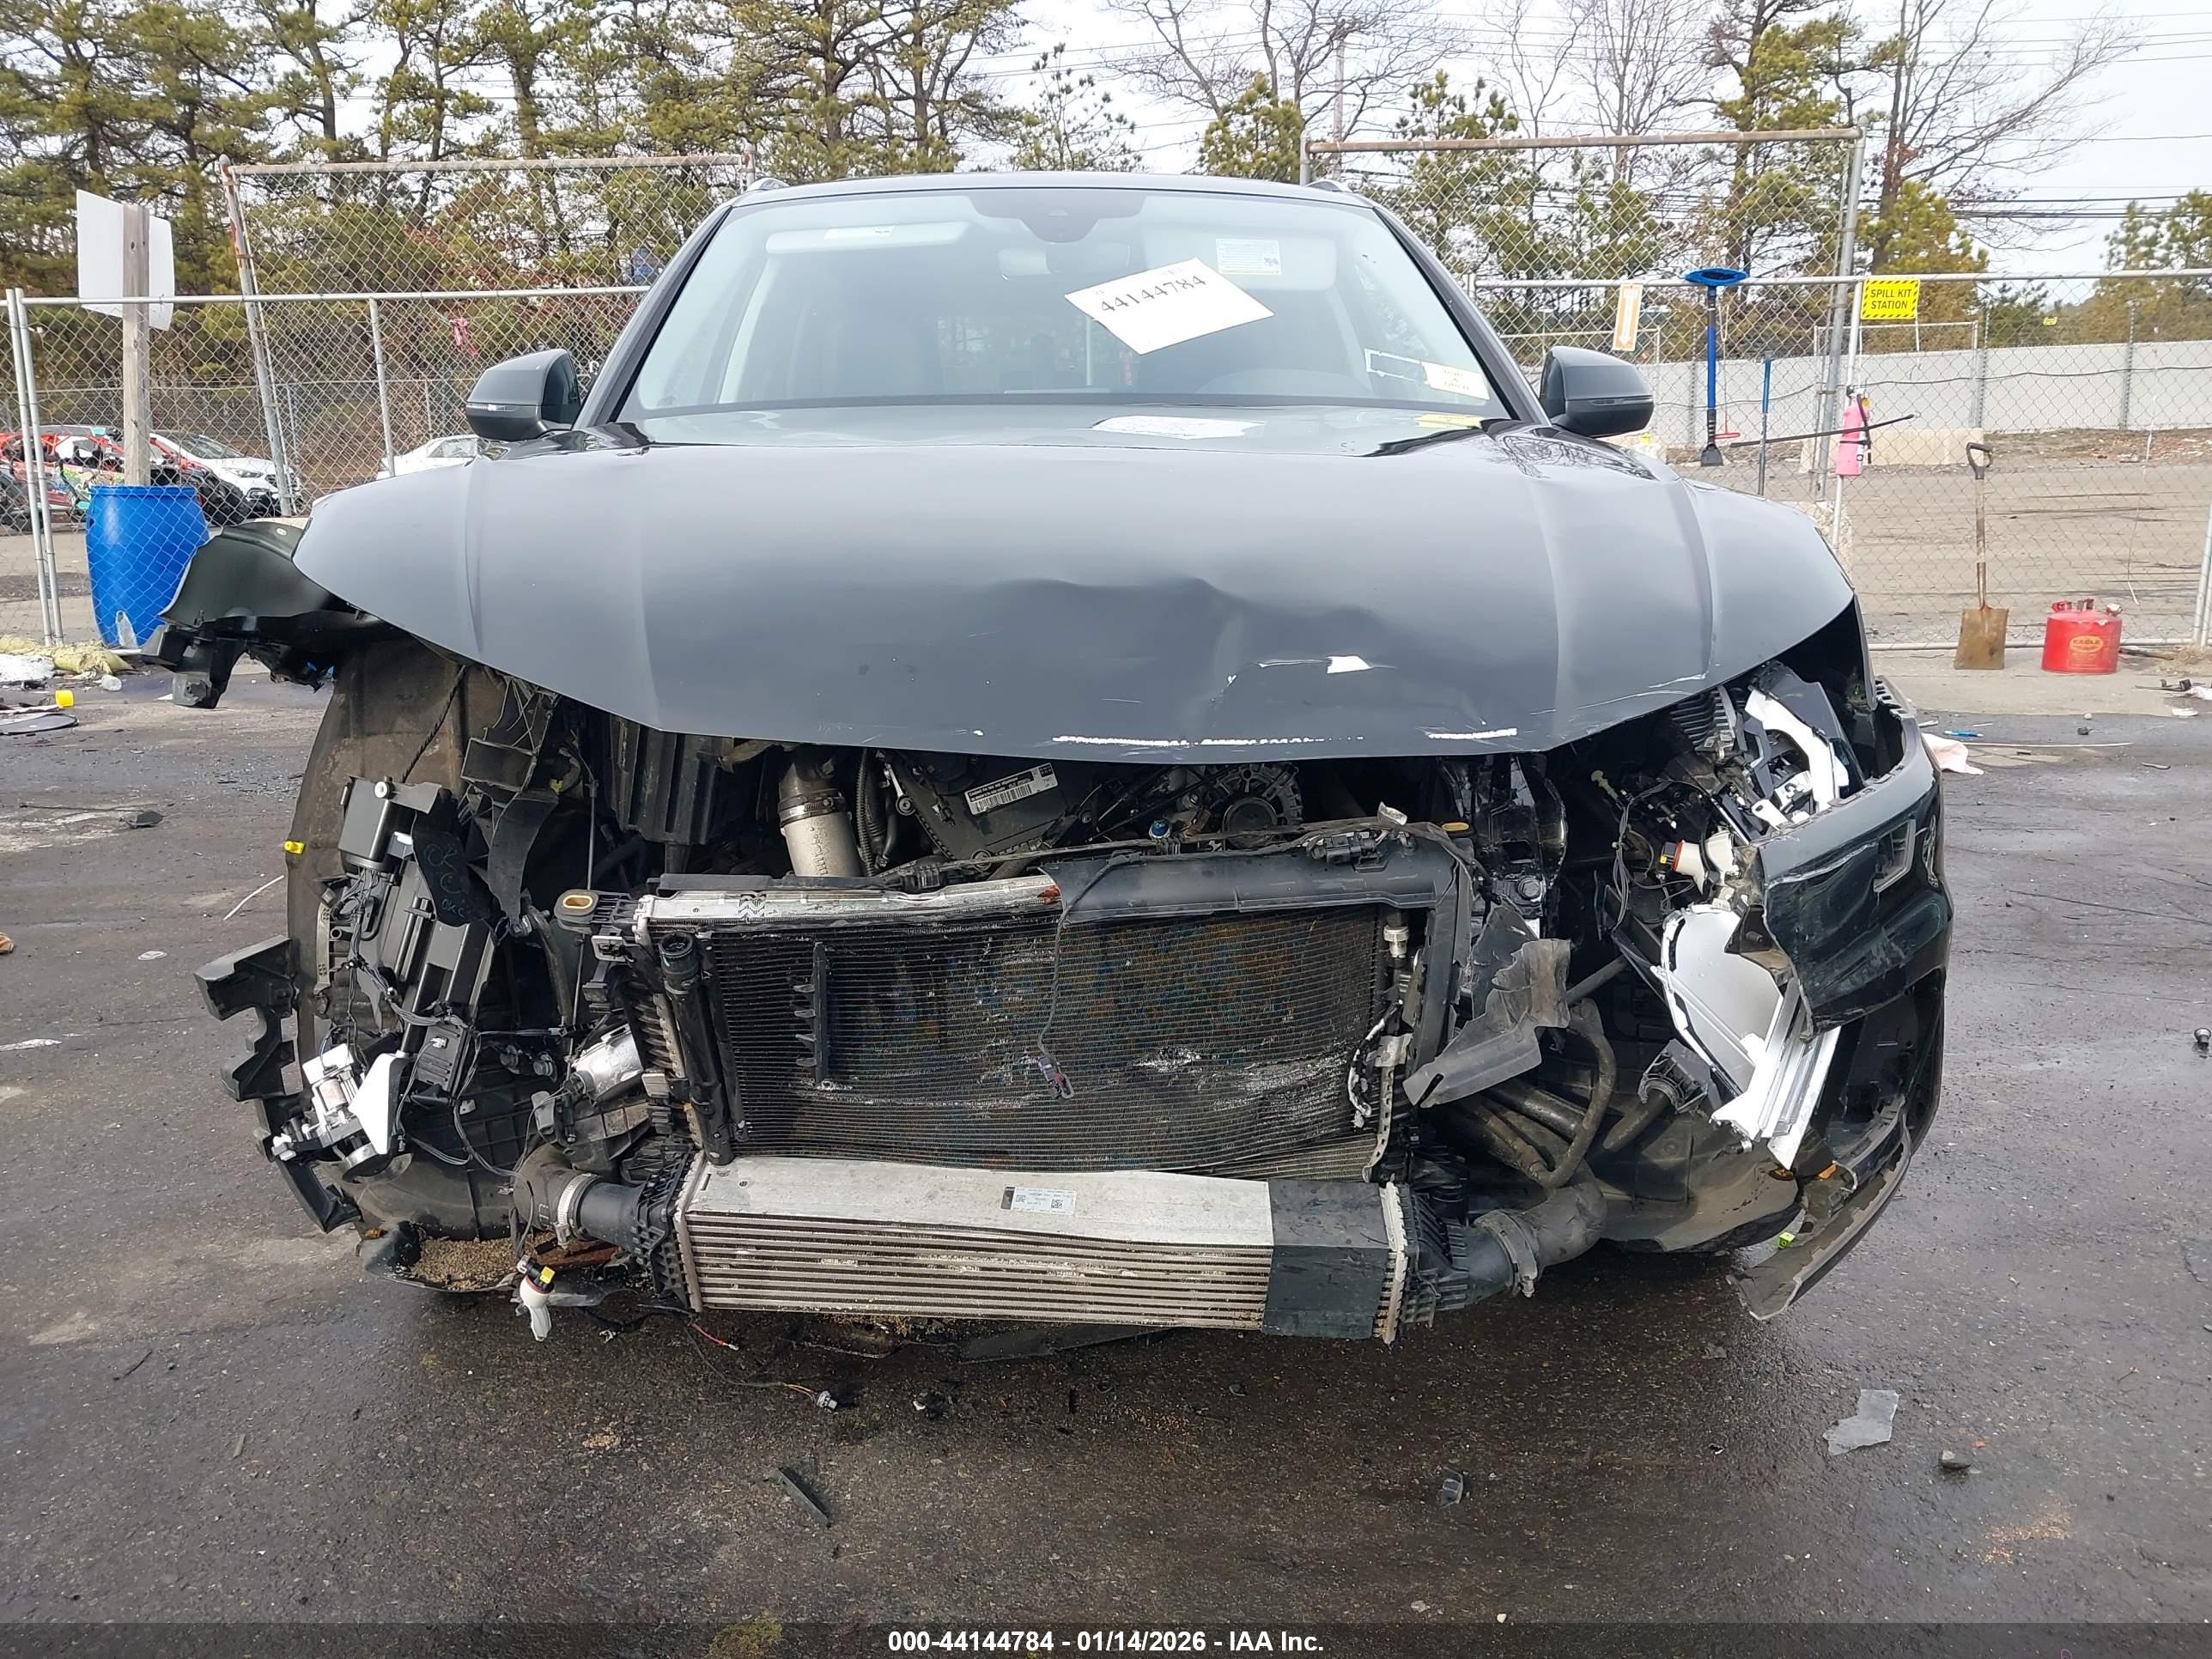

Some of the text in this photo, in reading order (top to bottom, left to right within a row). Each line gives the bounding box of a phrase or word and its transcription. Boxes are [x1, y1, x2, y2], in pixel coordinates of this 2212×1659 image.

[1101, 275, 1206, 312] 44144784
[1870, 289, 1911, 298] SPILL KIT
[1871, 301, 1908, 310] STATION
